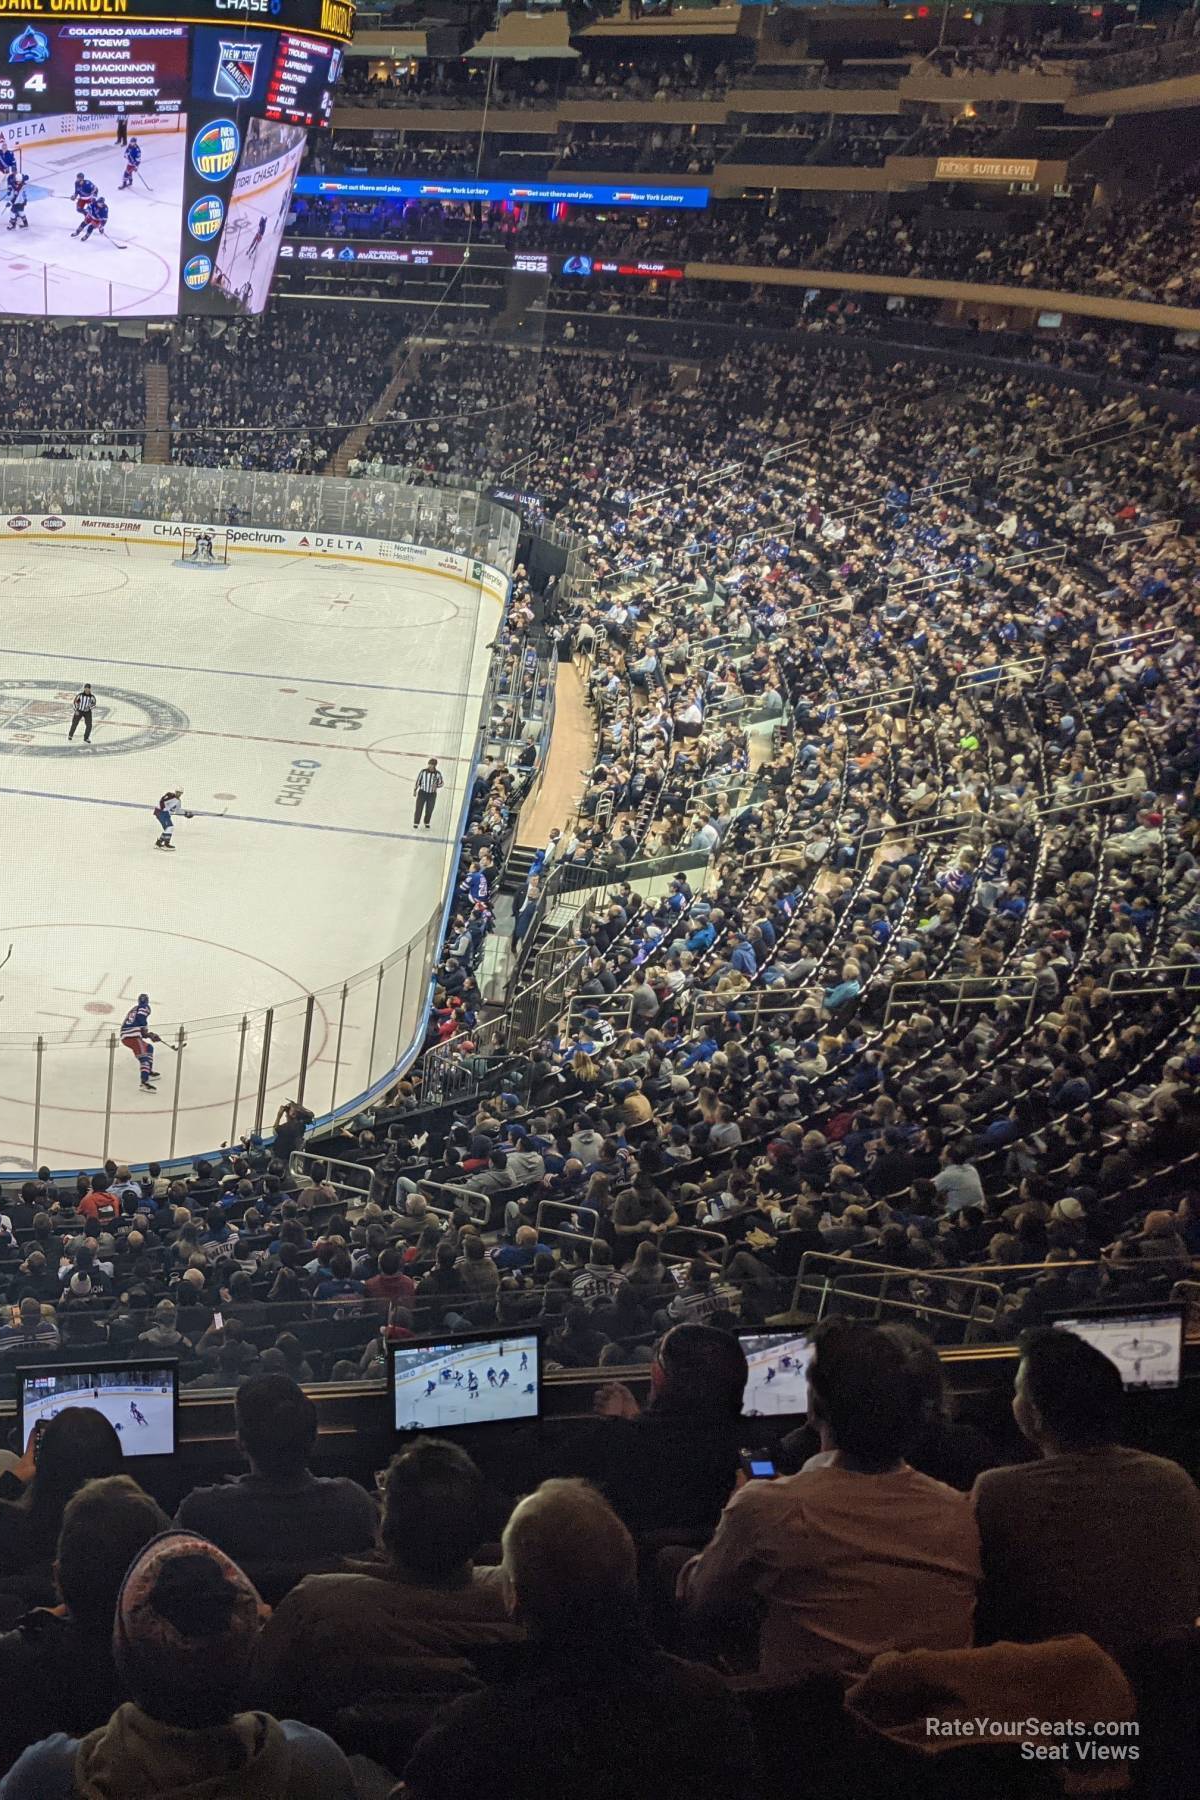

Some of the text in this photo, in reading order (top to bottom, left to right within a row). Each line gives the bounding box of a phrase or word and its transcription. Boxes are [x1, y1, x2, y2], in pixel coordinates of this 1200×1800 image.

[51, 0, 127, 12] GARDEN
[216, 0, 268, 11] CHASE
[69, 28, 183, 36] COLORADO AVALANCHE
[92, 39, 131, 47] TOEWS
[92, 52, 131, 60] MAKAR
[221, 49, 257, 60] NEW YORK
[91, 64, 156, 72] MACKINNON
[24, 74, 47, 92] 4
[91, 76, 155, 84] LANDESKOG
[225, 62, 251, 94] RANGERS
[91, 89, 161, 97] BURAKOVSKY
[8, 123, 46, 140] DELTA
[76, 123, 99, 131] Health
[220, 127, 235, 138] NEW
[973, 163, 1001, 174] SUITE
[1002, 163, 1032, 175] LEVEL
[387, 185, 402, 193] play.
[438, 186, 489, 196] New York Lottery
[579, 192, 594, 200] play.
[660, 194, 684, 203] Lottery
[280, 246, 293, 257] 2
[321, 248, 335, 259] 4
[357, 253, 409, 261] AVALANCHE
[514, 254, 548, 262] FACEOFFS
[512, 262, 548, 272] .552
[519, 496, 541, 507] ULTRA
[226, 529, 282, 544] Spectrum
[315, 537, 363, 551] DELTA
[308, 706, 369, 731] 5G
[274, 769, 317, 807] CHASE
